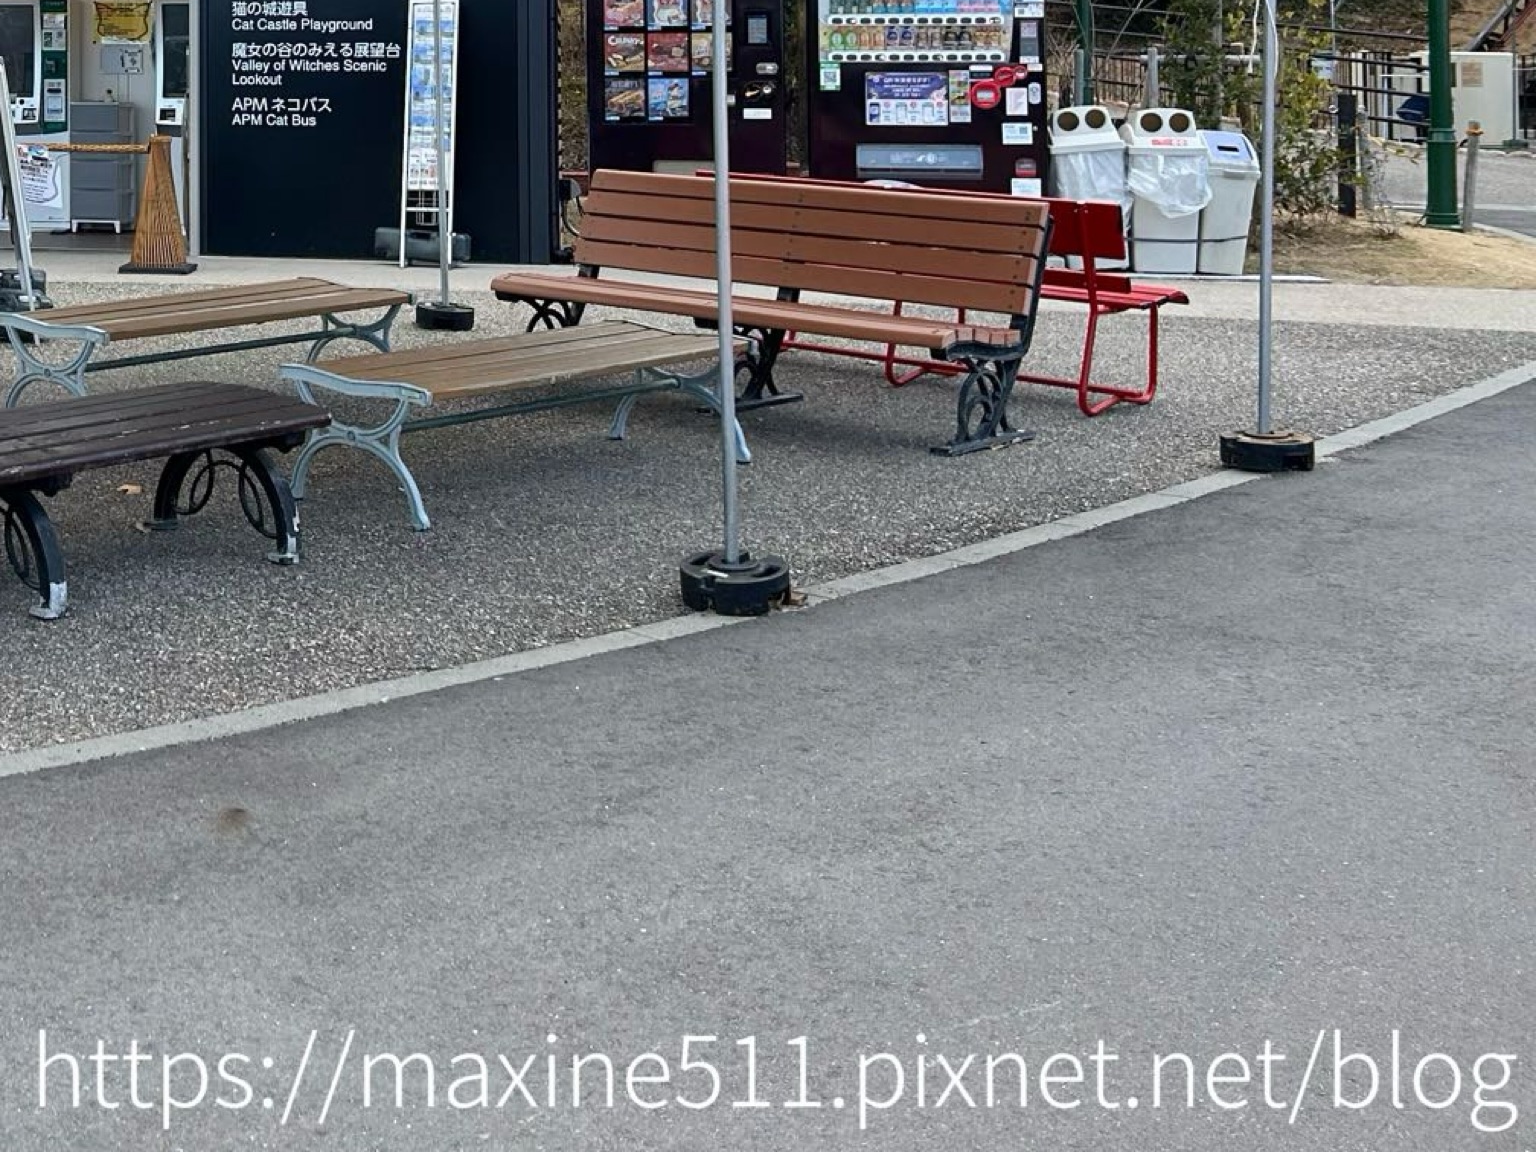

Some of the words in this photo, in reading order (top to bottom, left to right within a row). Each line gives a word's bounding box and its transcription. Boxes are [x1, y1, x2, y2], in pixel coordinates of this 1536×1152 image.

[232, 1, 308, 16] 猫の城遊具
[232, 18, 254, 30] Cat
[257, 18, 297, 30] Castle
[301, 18, 373, 33] Playground
[232, 42, 401, 58] 魔女の谷のみえる展望台
[232, 59, 270, 73] Valley
[273, 59, 286, 71] of
[289, 59, 340, 72] Witches
[343, 59, 387, 72] Scenic
[232, 73, 282, 85] Lookout
[232, 98, 268, 111] APM
[271, 97, 332, 112] ネコバス
[232, 114, 263, 126] APM
[266, 114, 289, 126] Cat
[292, 114, 317, 126] Bus
